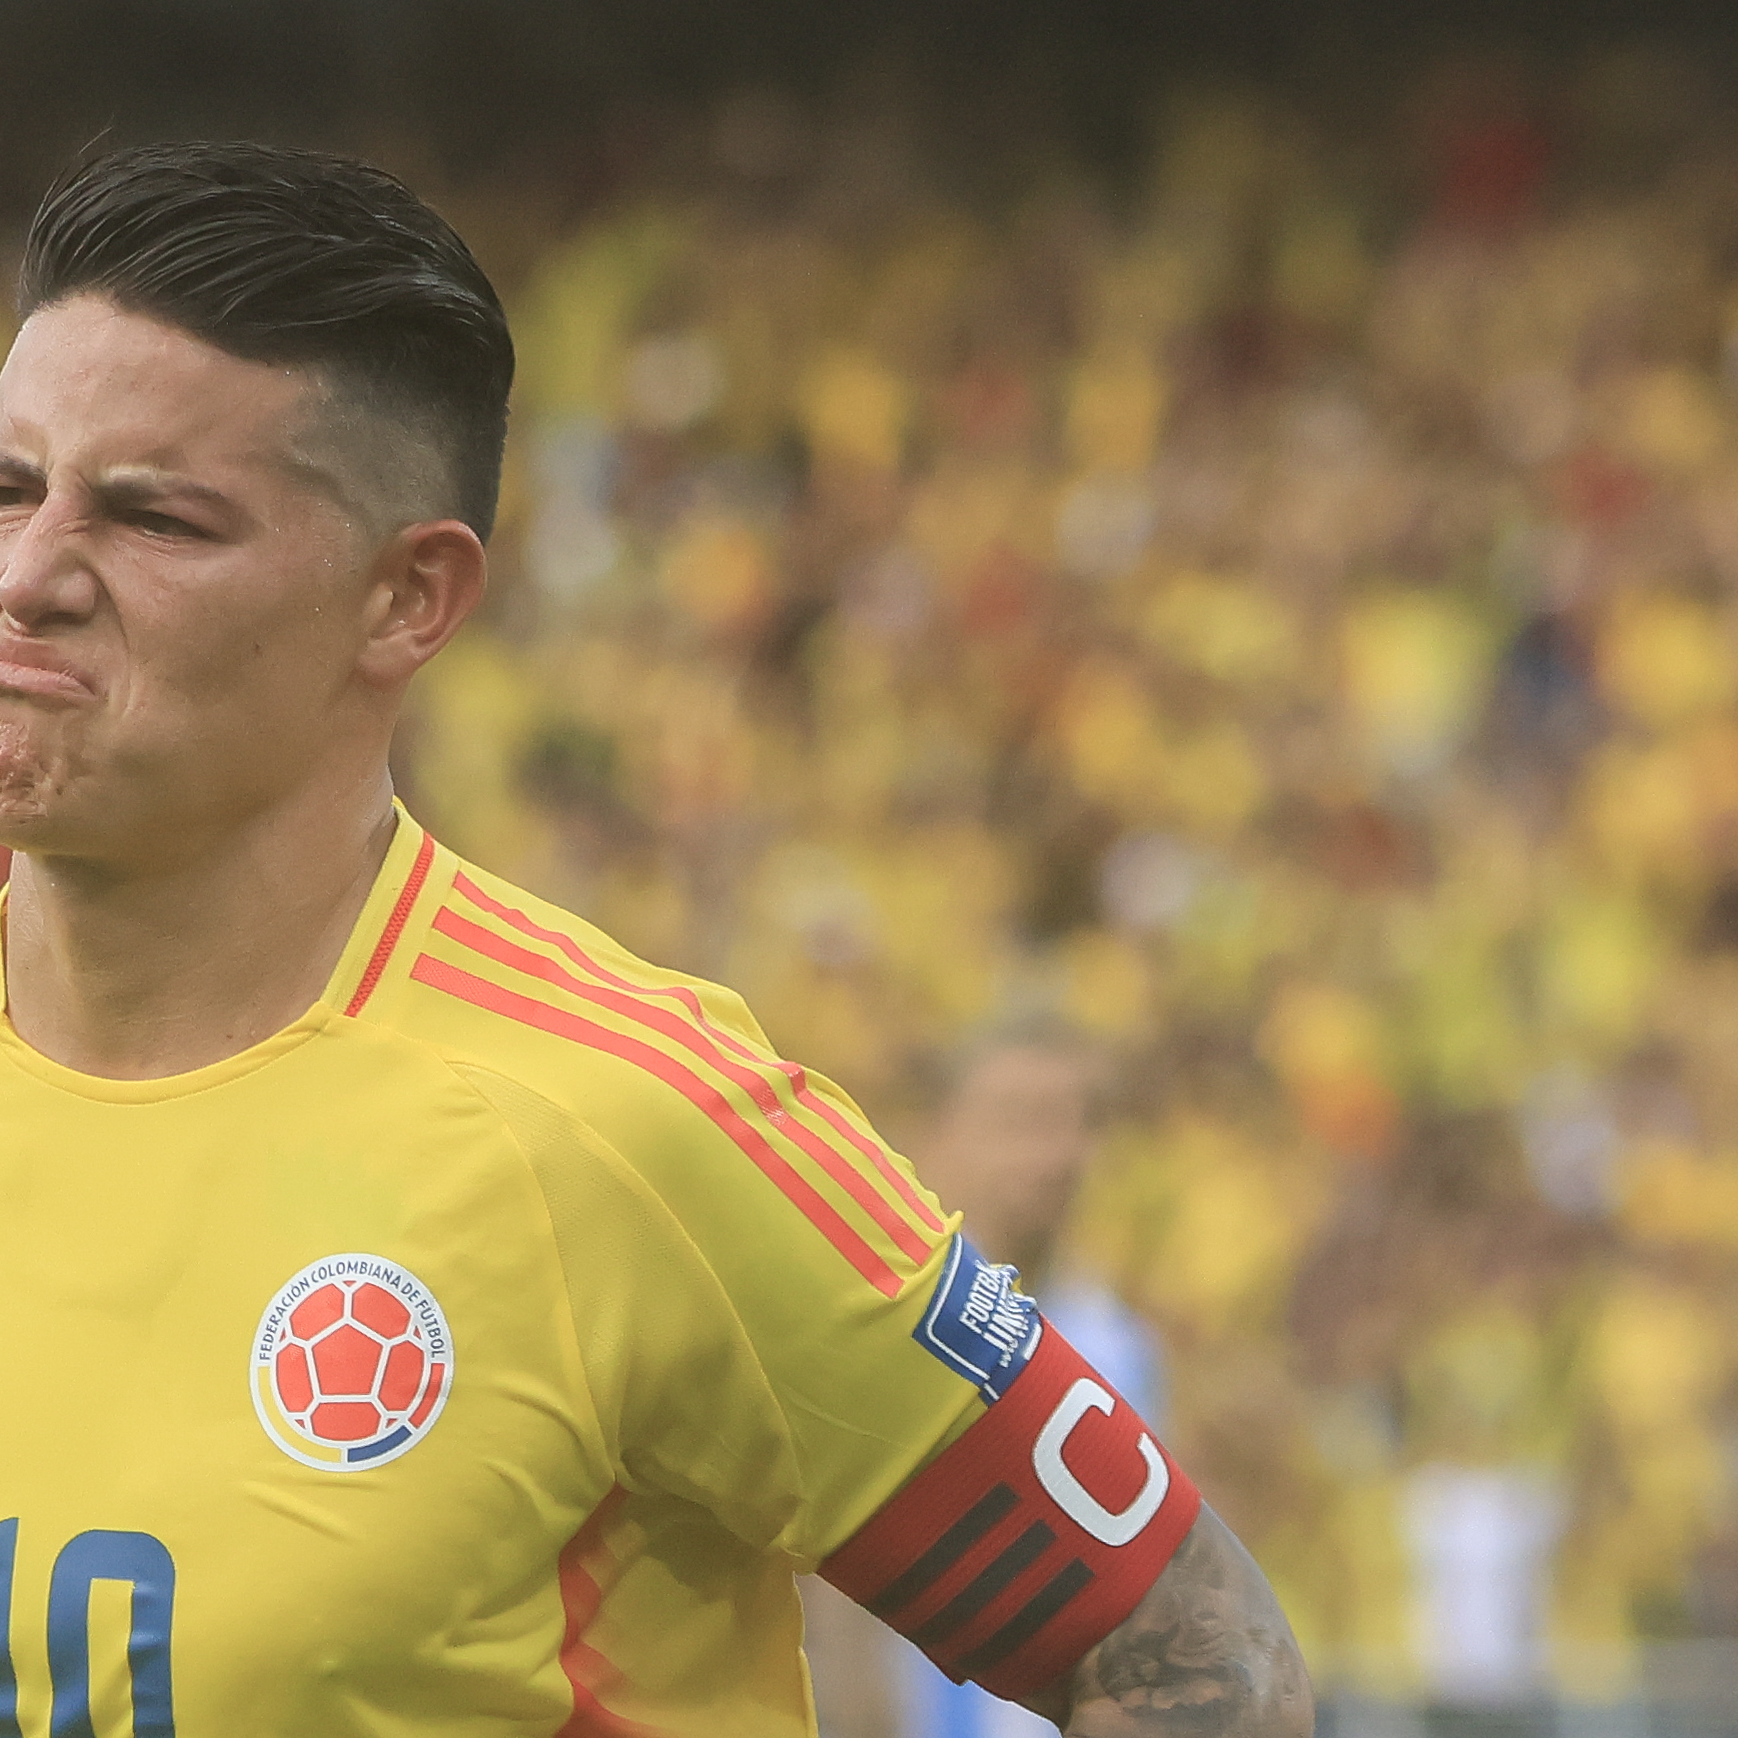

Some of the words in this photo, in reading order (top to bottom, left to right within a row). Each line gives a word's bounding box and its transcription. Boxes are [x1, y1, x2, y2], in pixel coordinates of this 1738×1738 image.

[311, 1261, 401, 1289] COLOMBIANA
[401, 1282, 421, 1302] DE
[959, 1259, 1002, 1335] FOOTBA
[1032, 1377, 1170, 1547] C
